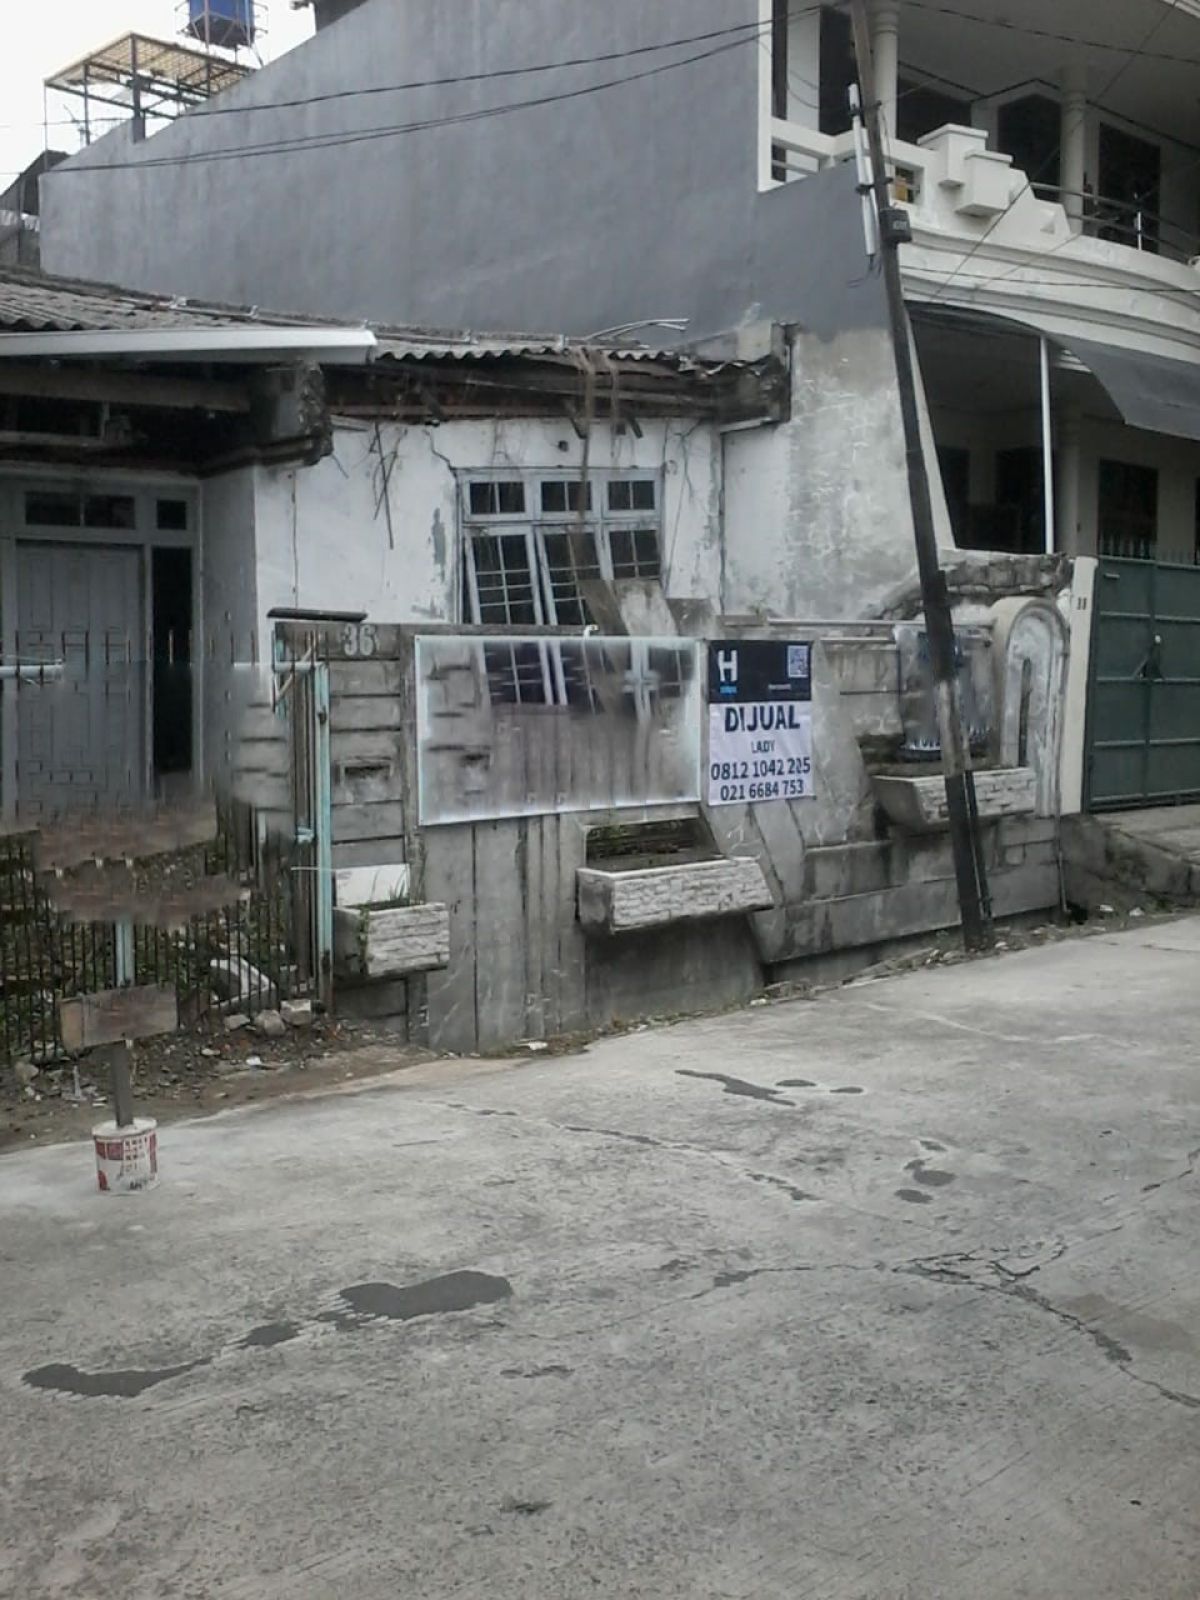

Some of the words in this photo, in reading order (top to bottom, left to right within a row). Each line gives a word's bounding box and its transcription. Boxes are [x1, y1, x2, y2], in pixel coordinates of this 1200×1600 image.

[344, 623, 375, 656] 36
[724, 705, 800, 732] DIJUAL
[711, 761, 748, 780] 0812
[753, 758, 784, 778] 1042
[720, 785, 745, 801] 021
[749, 780, 779, 799] 6684
[784, 778, 804, 795] 753
